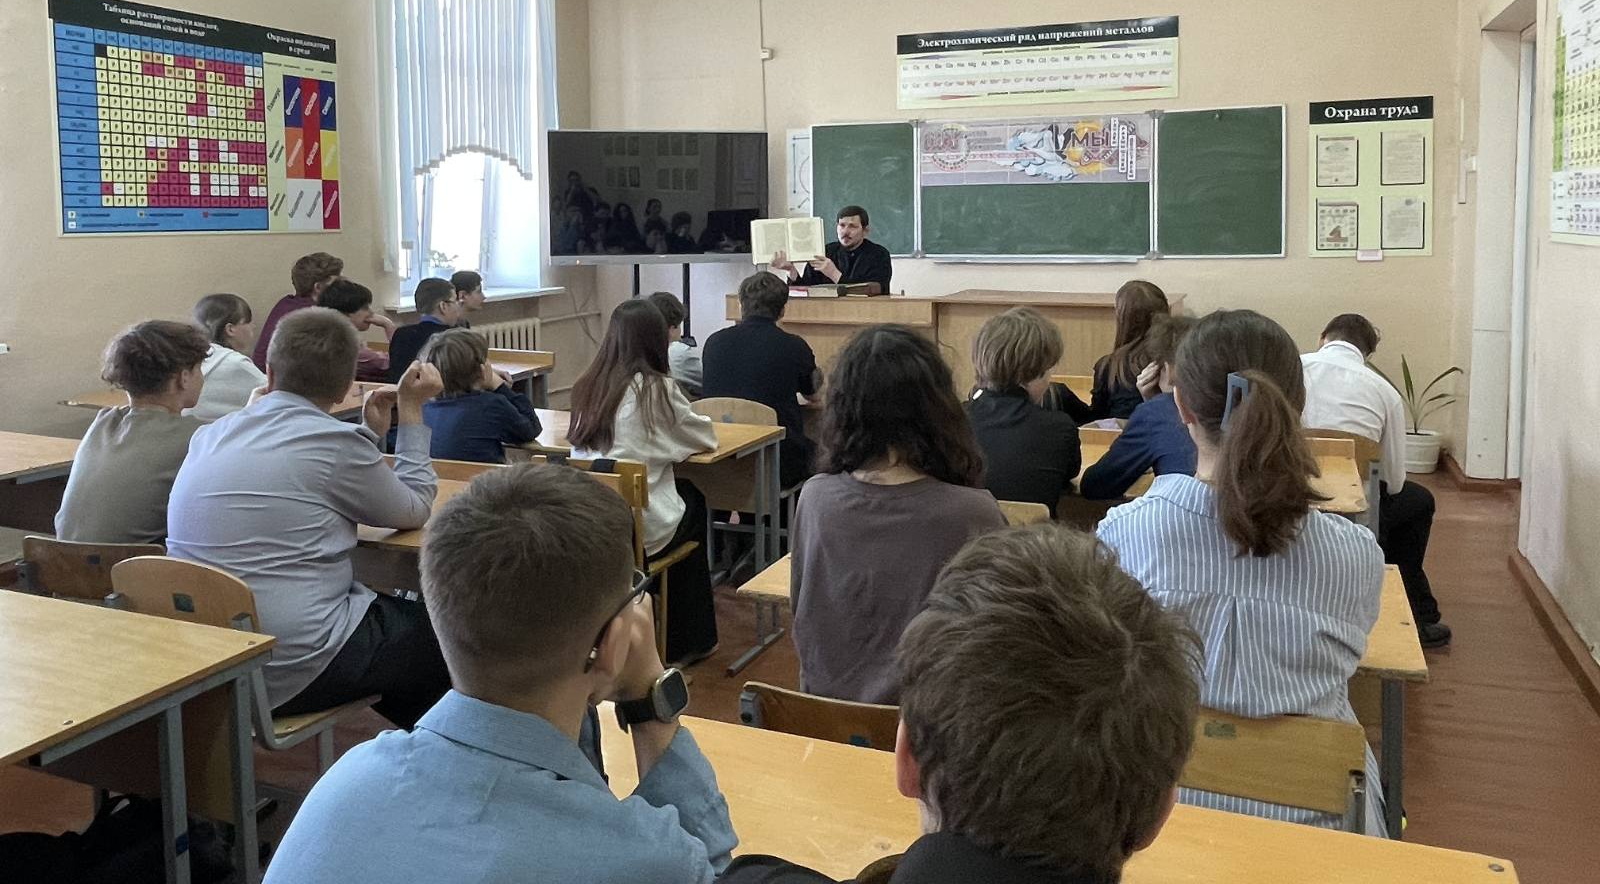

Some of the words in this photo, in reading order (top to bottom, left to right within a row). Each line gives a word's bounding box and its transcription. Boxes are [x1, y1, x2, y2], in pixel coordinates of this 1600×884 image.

[102, 2, 136, 16] Таблица
[137, 11, 193, 25] растворимости
[917, 33, 1016, 48] Электрохимический
[1018, 34, 1037, 44] ряд
[1038, 27, 1103, 41] напряжений
[1105, 25, 1154, 36] металлов
[1324, 106, 1377, 120] Охрана
[1379, 105, 1419, 118] труда
